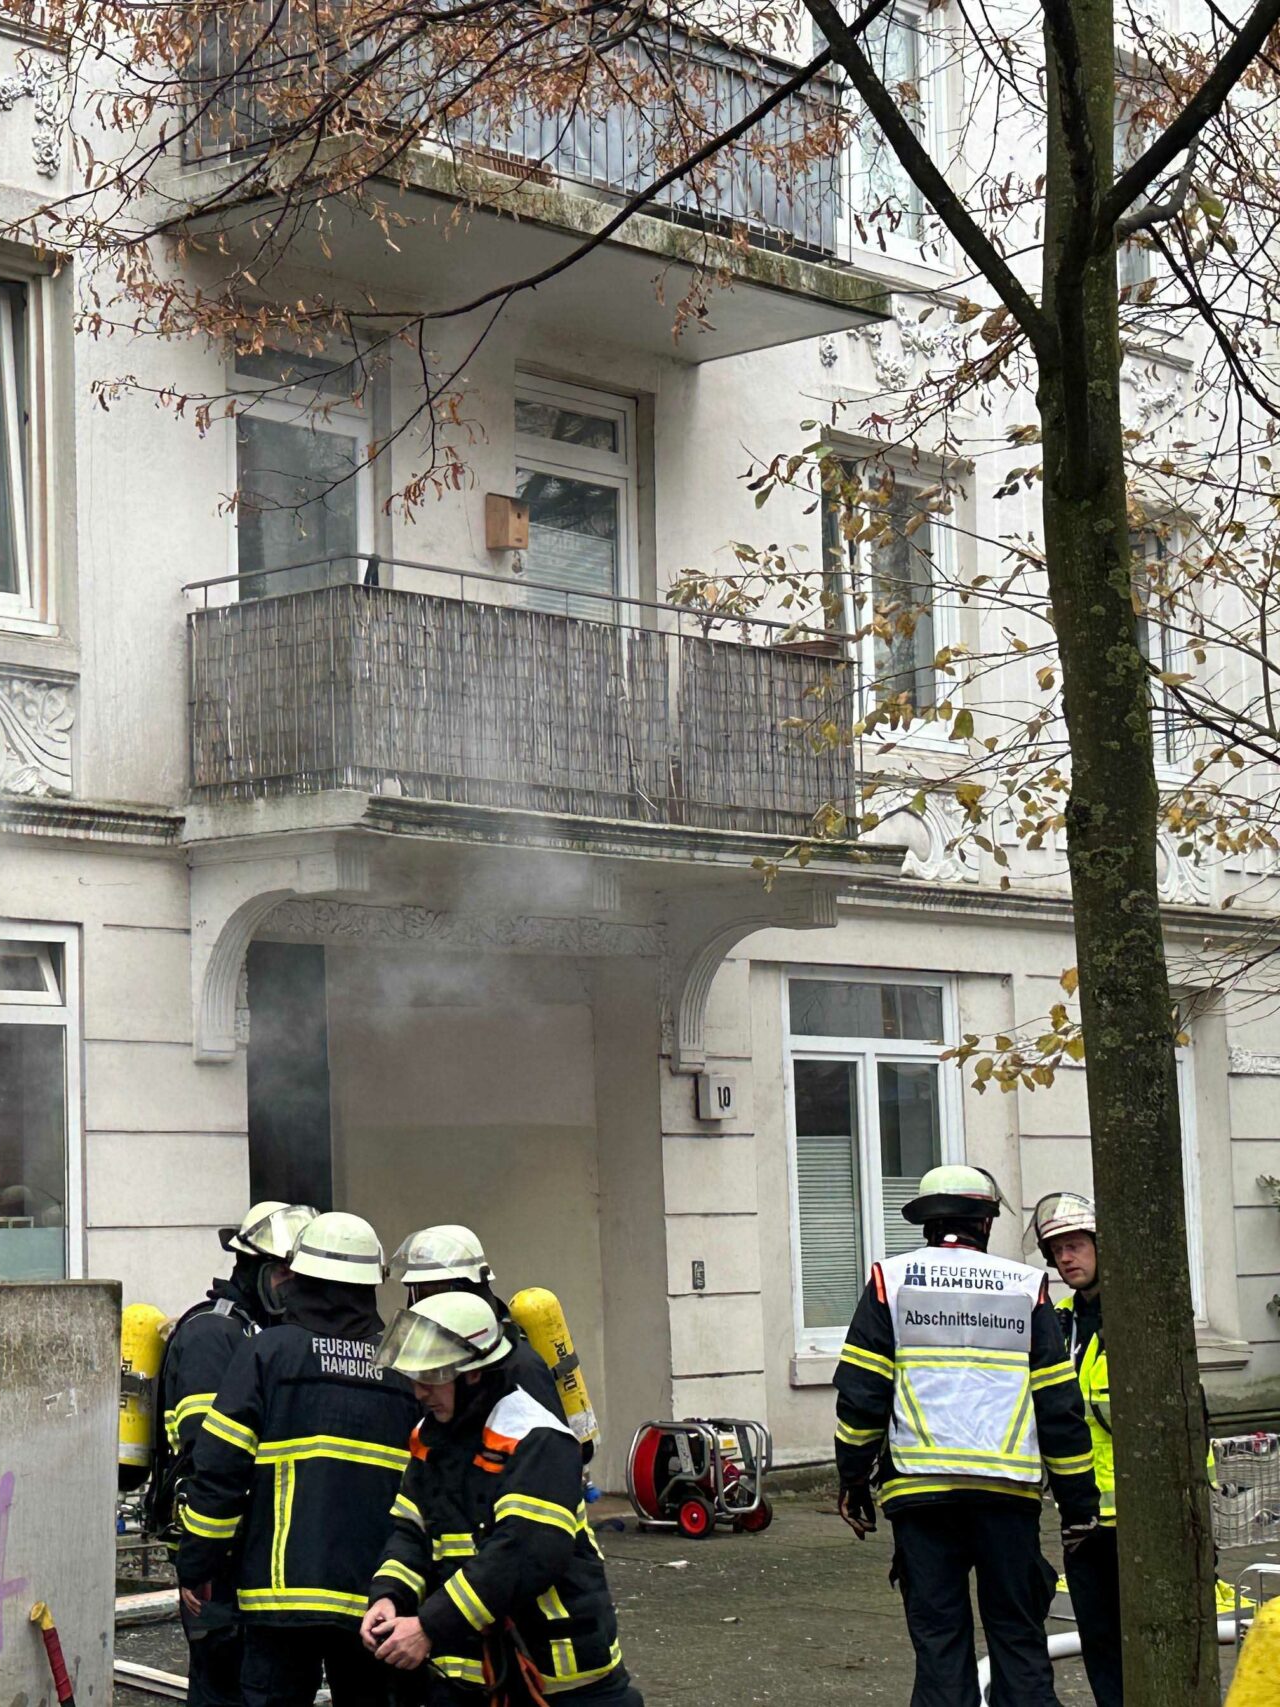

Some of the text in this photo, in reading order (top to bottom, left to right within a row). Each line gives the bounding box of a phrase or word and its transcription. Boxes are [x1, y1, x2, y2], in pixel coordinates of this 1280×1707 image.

[717, 1086, 731, 1110] 10
[930, 1265, 1023, 1282] FEUERWEHR
[930, 1277, 1005, 1291] HAMBURG
[904, 1310, 1026, 1334] Abschnittsleitung
[321, 1355, 384, 1381] HAMBURG
